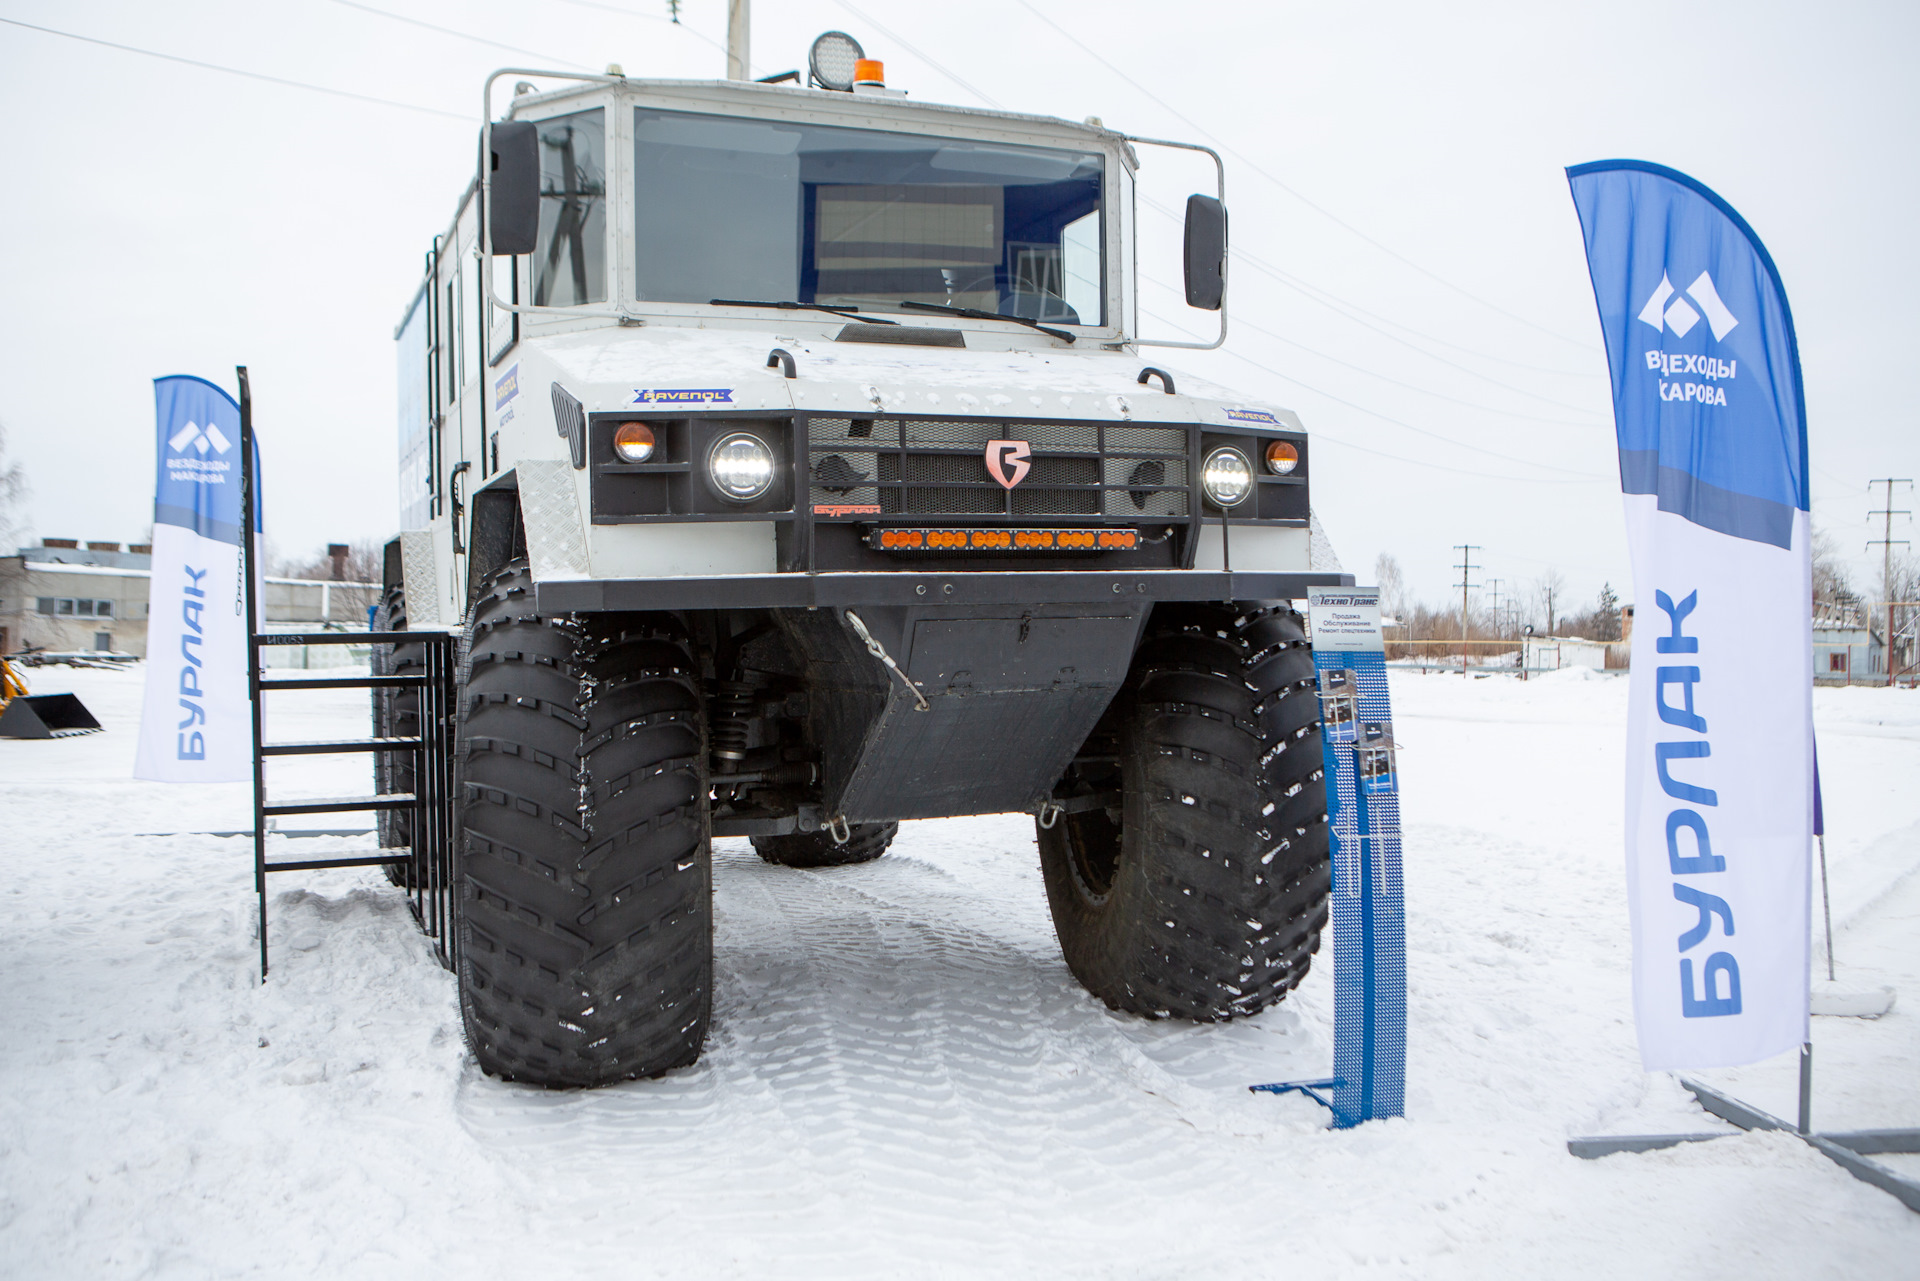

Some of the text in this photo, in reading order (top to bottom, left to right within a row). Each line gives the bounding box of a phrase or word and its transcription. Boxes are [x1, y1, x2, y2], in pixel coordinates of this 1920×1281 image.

[1645, 350, 1737, 381] ВДЕХОДЫ
[643, 391, 725, 400] RAVENOL
[1658, 378, 1727, 406] КАРОВА
[1228, 410, 1274, 423] RAVENOL
[176, 563, 207, 761] БУРЛАК
[1655, 588, 1742, 1019] БУРЛАК
